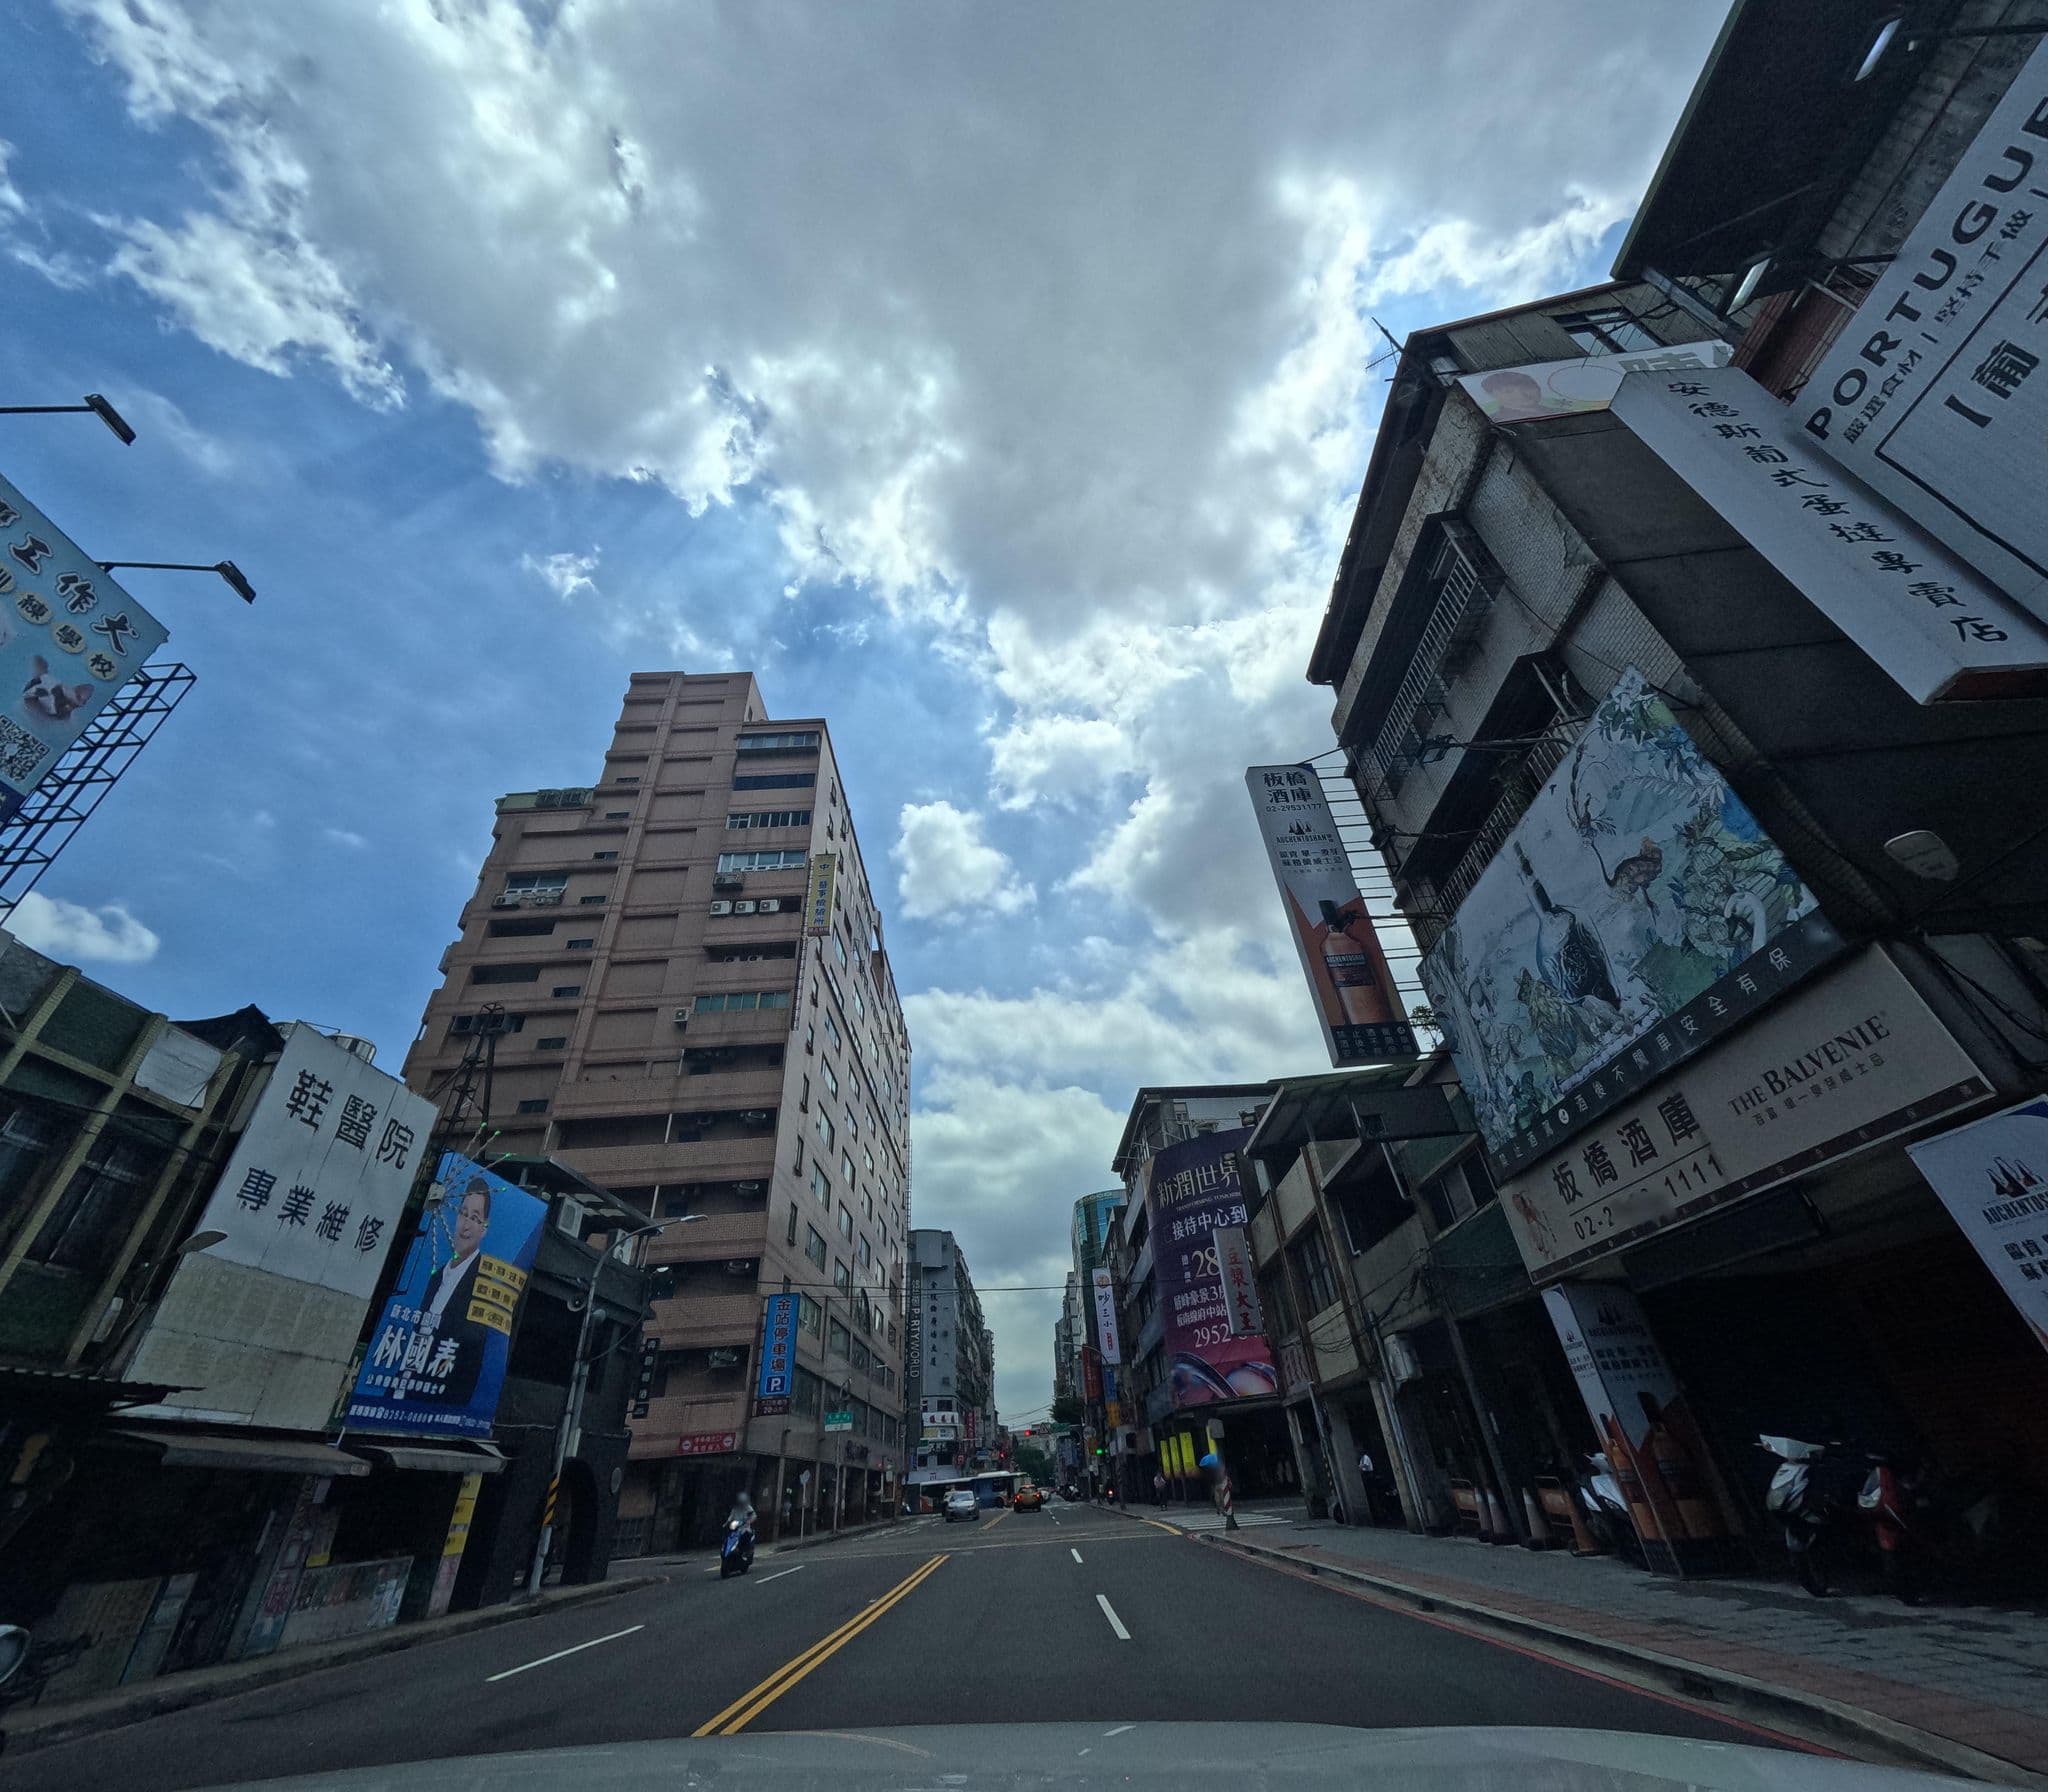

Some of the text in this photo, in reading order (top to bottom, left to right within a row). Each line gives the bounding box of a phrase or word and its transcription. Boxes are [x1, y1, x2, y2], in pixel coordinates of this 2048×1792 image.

[1263, 772, 1307, 787] 板橋
[1267, 788, 1313, 803] 酒庫
[1574, 925, 1836, 1113] 酒後不開車安全有保
[1728, 1015, 1890, 1116] THE BALVENIE
[286, 1069, 416, 1170] 鞋醫院
[1552, 1092, 1700, 1205] 板橋酒庫
[237, 1167, 385, 1252] 專業維修
[1172, 1203, 1248, 1241] 接待中心到
[372, 1325, 460, 1379] 林國春
[770, 1297, 792, 1371] 金站停車場
[910, 1308, 921, 1378] PRTYWORLD
